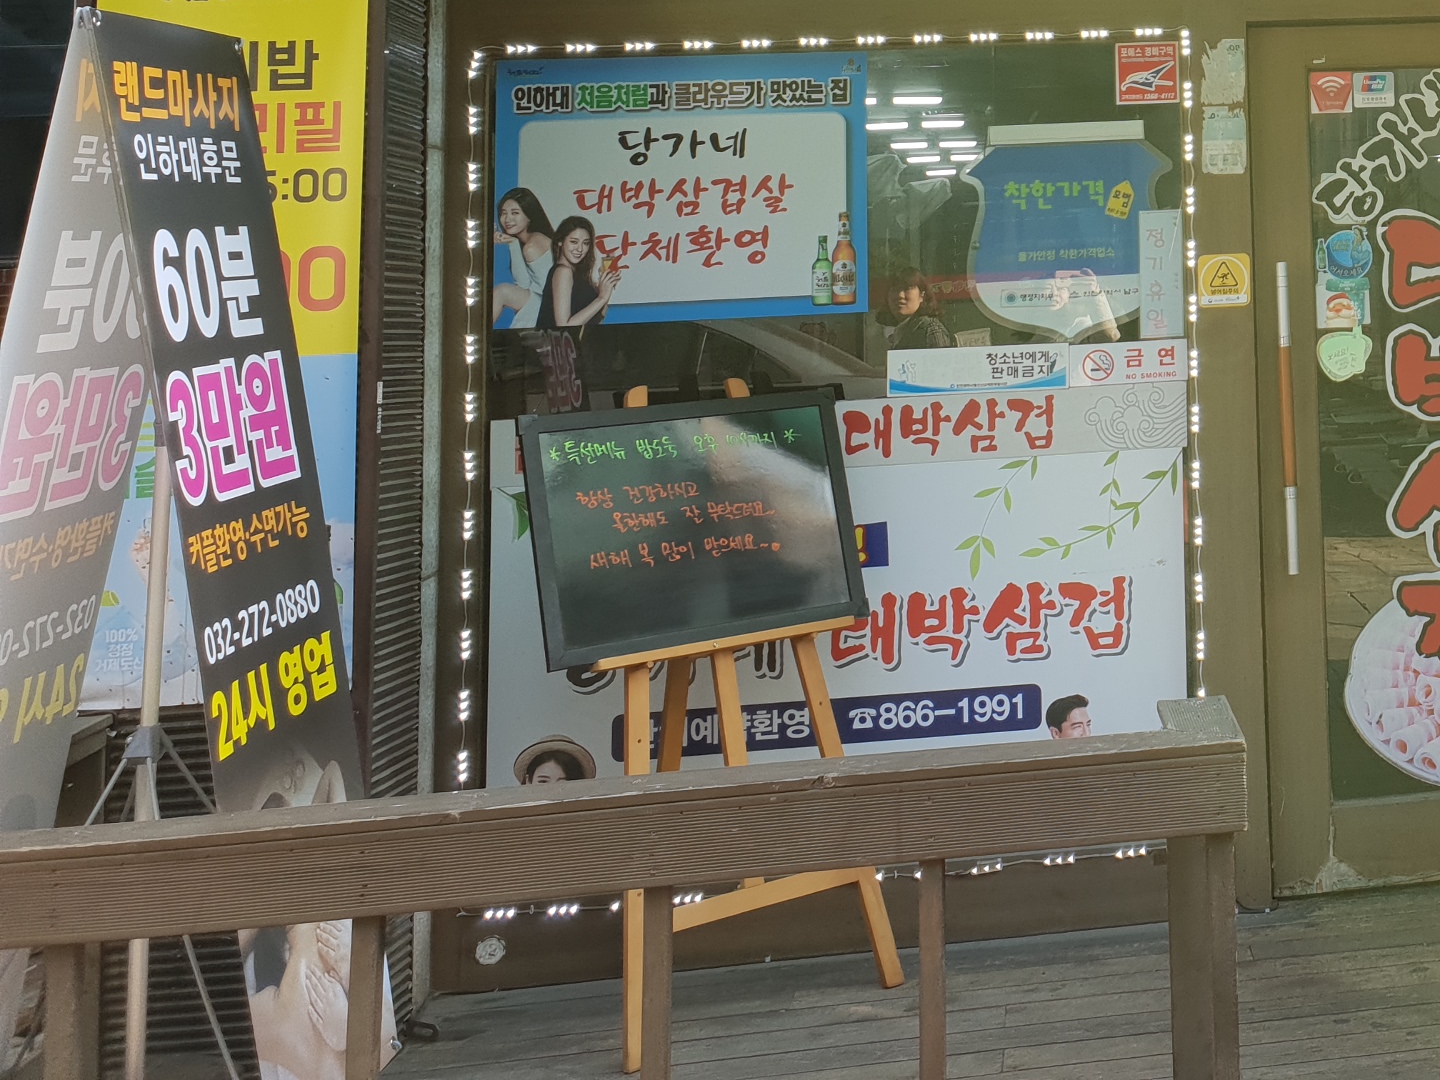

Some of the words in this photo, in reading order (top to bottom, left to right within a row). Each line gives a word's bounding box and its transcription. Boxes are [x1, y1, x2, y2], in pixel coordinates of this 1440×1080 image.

[1144, 46, 1174, 57] 경비구역
[112, 59, 241, 133] 랜드마사지
[512, 83, 572, 113] 인하대
[575, 80, 671, 111] 처음처럼과
[674, 78, 765, 109] 클라우드가
[769, 77, 828, 107] 맛있는
[829, 76, 852, 105] 집
[133, 132, 243, 185] 인하대후문
[617, 126, 748, 167] 당가네
[572, 172, 795, 219] 대박삼겹살
[1003, 179, 1105, 211] 착한가격
[1112, 189, 1132, 209] 모범
[595, 224, 770, 272] 단체환영
[1058, 246, 1116, 260] 착한가격업소
[153, 224, 266, 344] 60분
[1145, 227, 1168, 330] 정기휴일
[1329, 264, 1363, 278] 어서오세요
[985, 350, 1050, 367] 청소년에게
[991, 363, 1050, 380] 판매금지
[1140, 370, 1178, 379] SMOKING
[165, 350, 302, 507] 3만원
[842, 393, 1056, 459] 대박삼겹
[692, 433, 719, 455] 오후
[575, 487, 614, 509] 항상
[622, 481, 700, 505] 건강하시고
[679, 504, 705, 524] 잘
[589, 548, 633, 570] 새해
[637, 542, 655, 568] 복
[660, 540, 696, 563] 많이
[104, 628, 139, 643] 100%
[203, 579, 321, 665] 032-272-0880
[211, 662, 277, 762] 24시
[278, 630, 338, 717] 영업
[877, 692, 1026, 731] 866-1991
